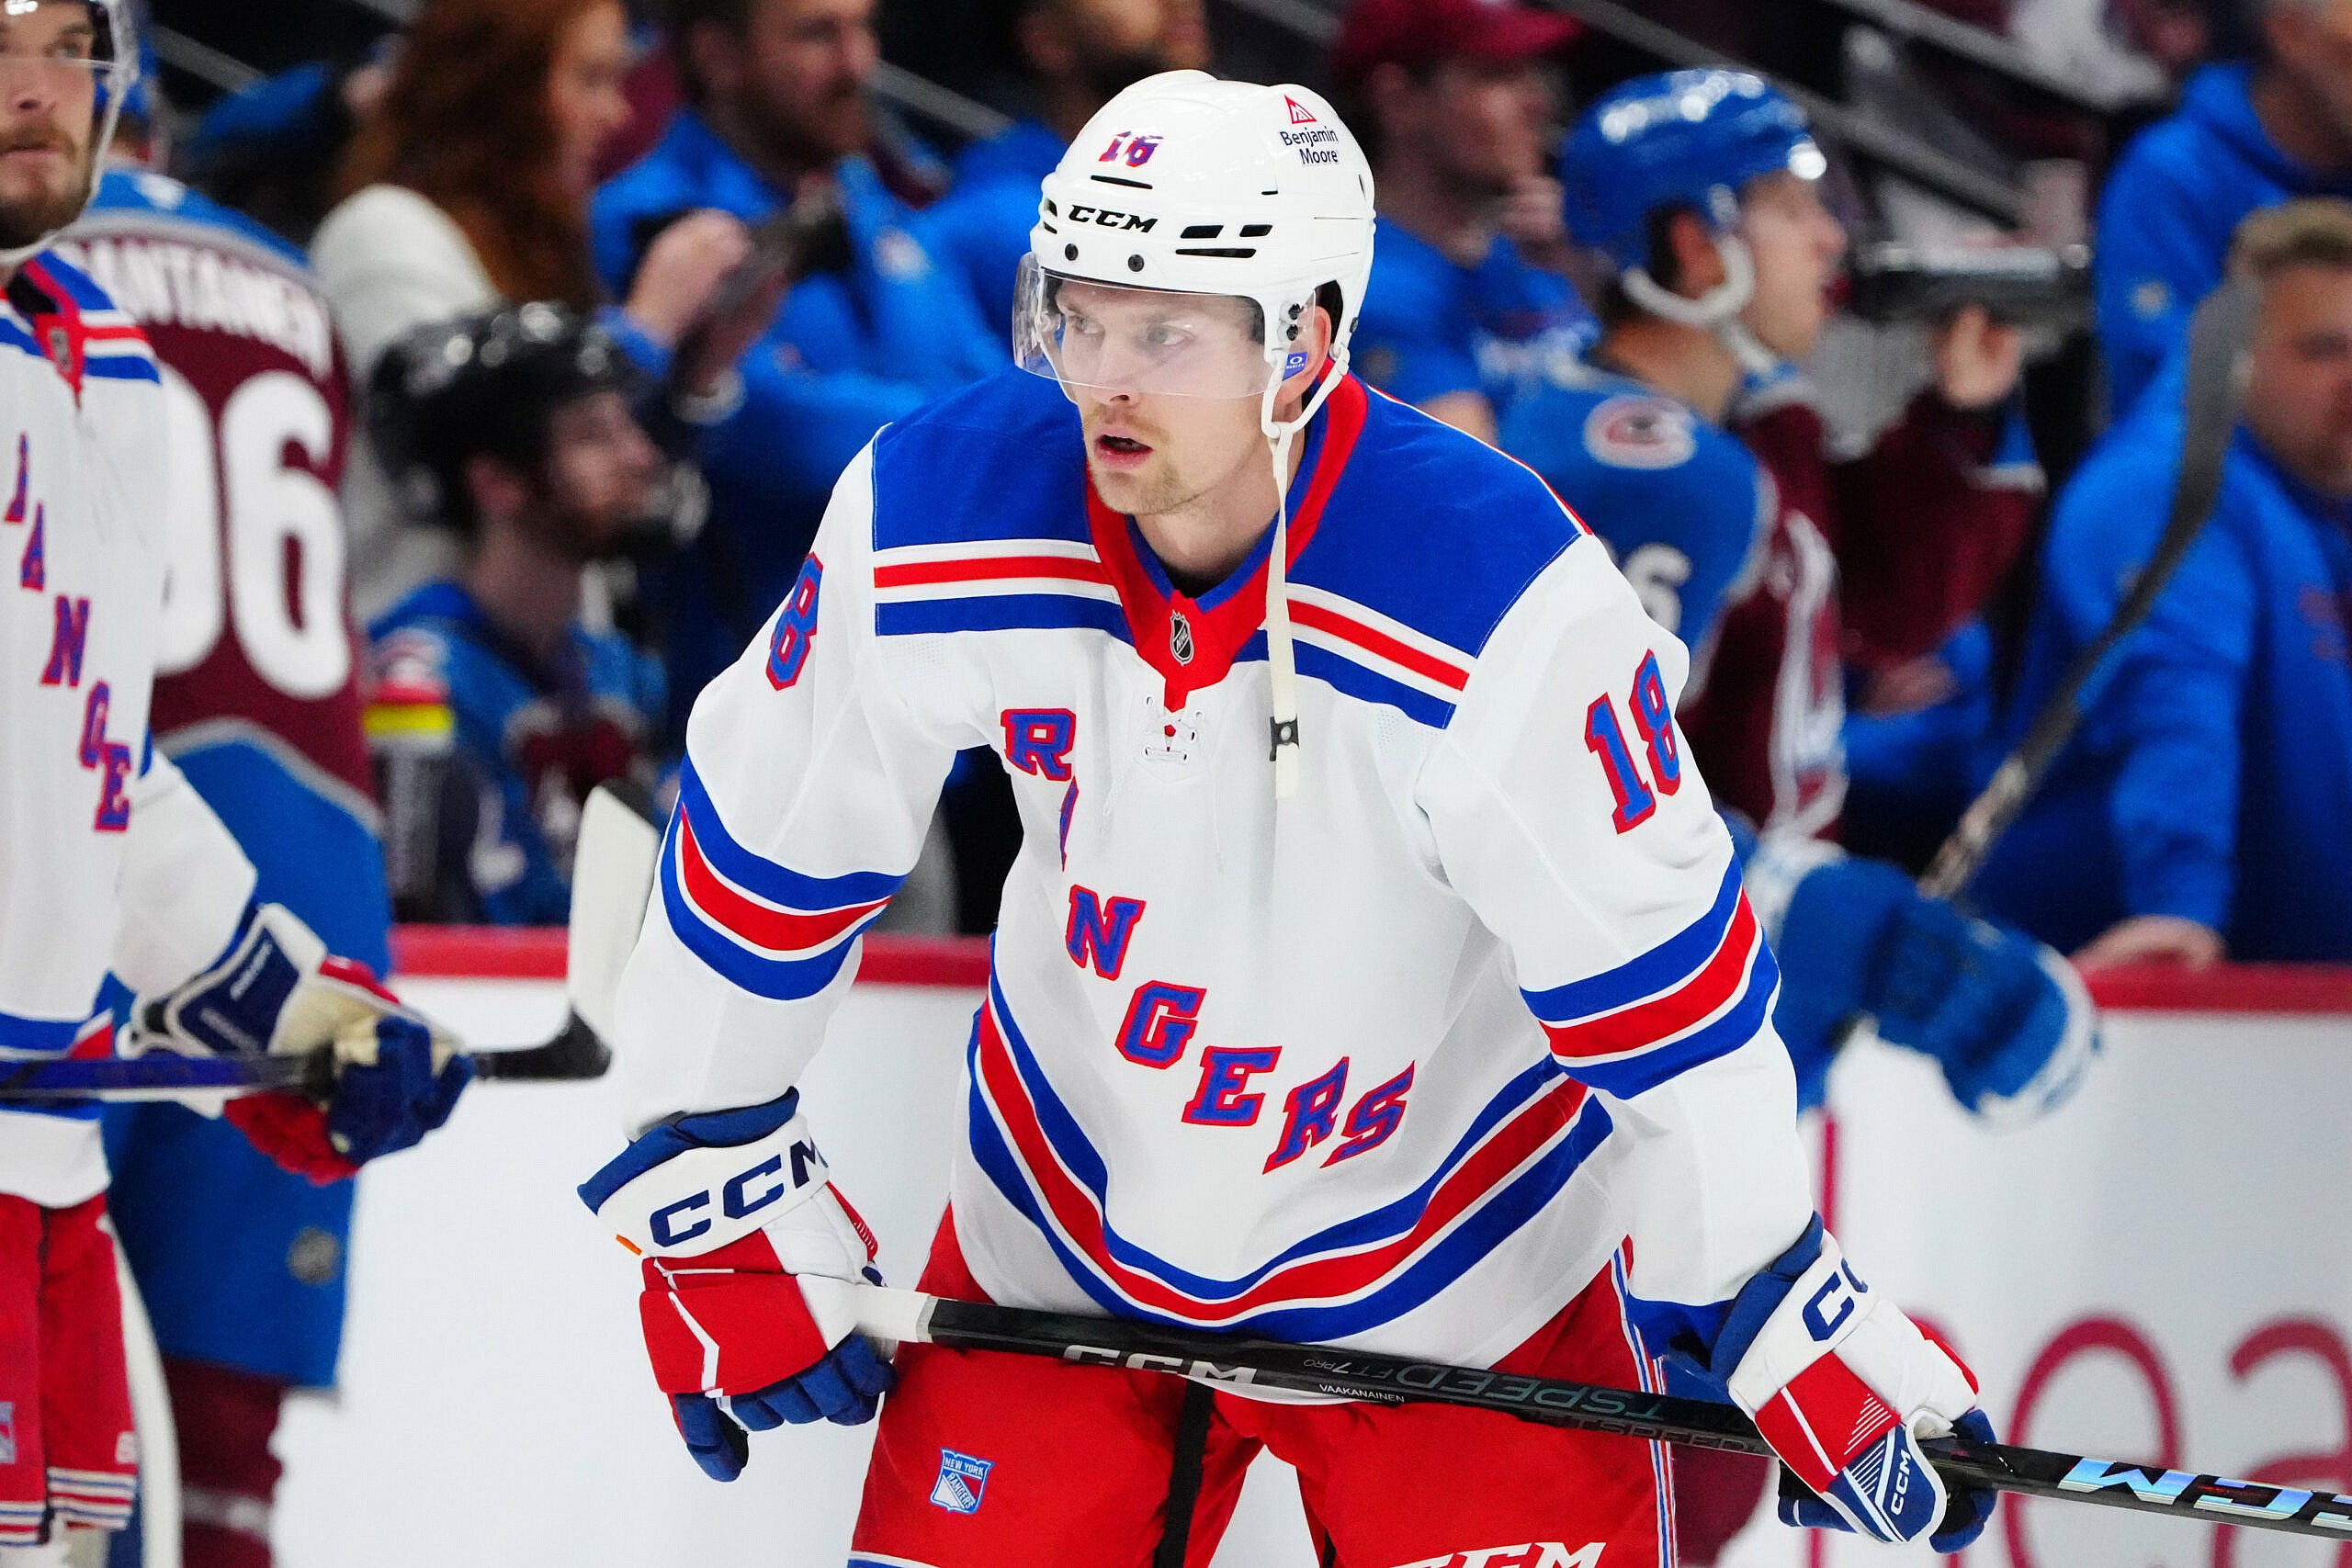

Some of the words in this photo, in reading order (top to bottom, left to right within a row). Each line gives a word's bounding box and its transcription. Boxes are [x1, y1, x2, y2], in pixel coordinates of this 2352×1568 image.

[1279, 125, 1339, 147] Benjamin
[1299, 147, 1339, 164] Moore
[1068, 204, 1159, 234] CCM
[1584, 648, 1681, 835] 18
[1000, 707, 1416, 1175] RNGERS
[649, 1139, 829, 1247] CCM
[1063, 1344, 1258, 1384] CCM
[1318, 1383, 1406, 1404] VAAKANAINEN
[944, 1457, 963, 1470] NEW
[965, 1462, 984, 1476] YORK
[1890, 1450, 1911, 1516] CCM
[947, 1472, 974, 1508] RANGERS
